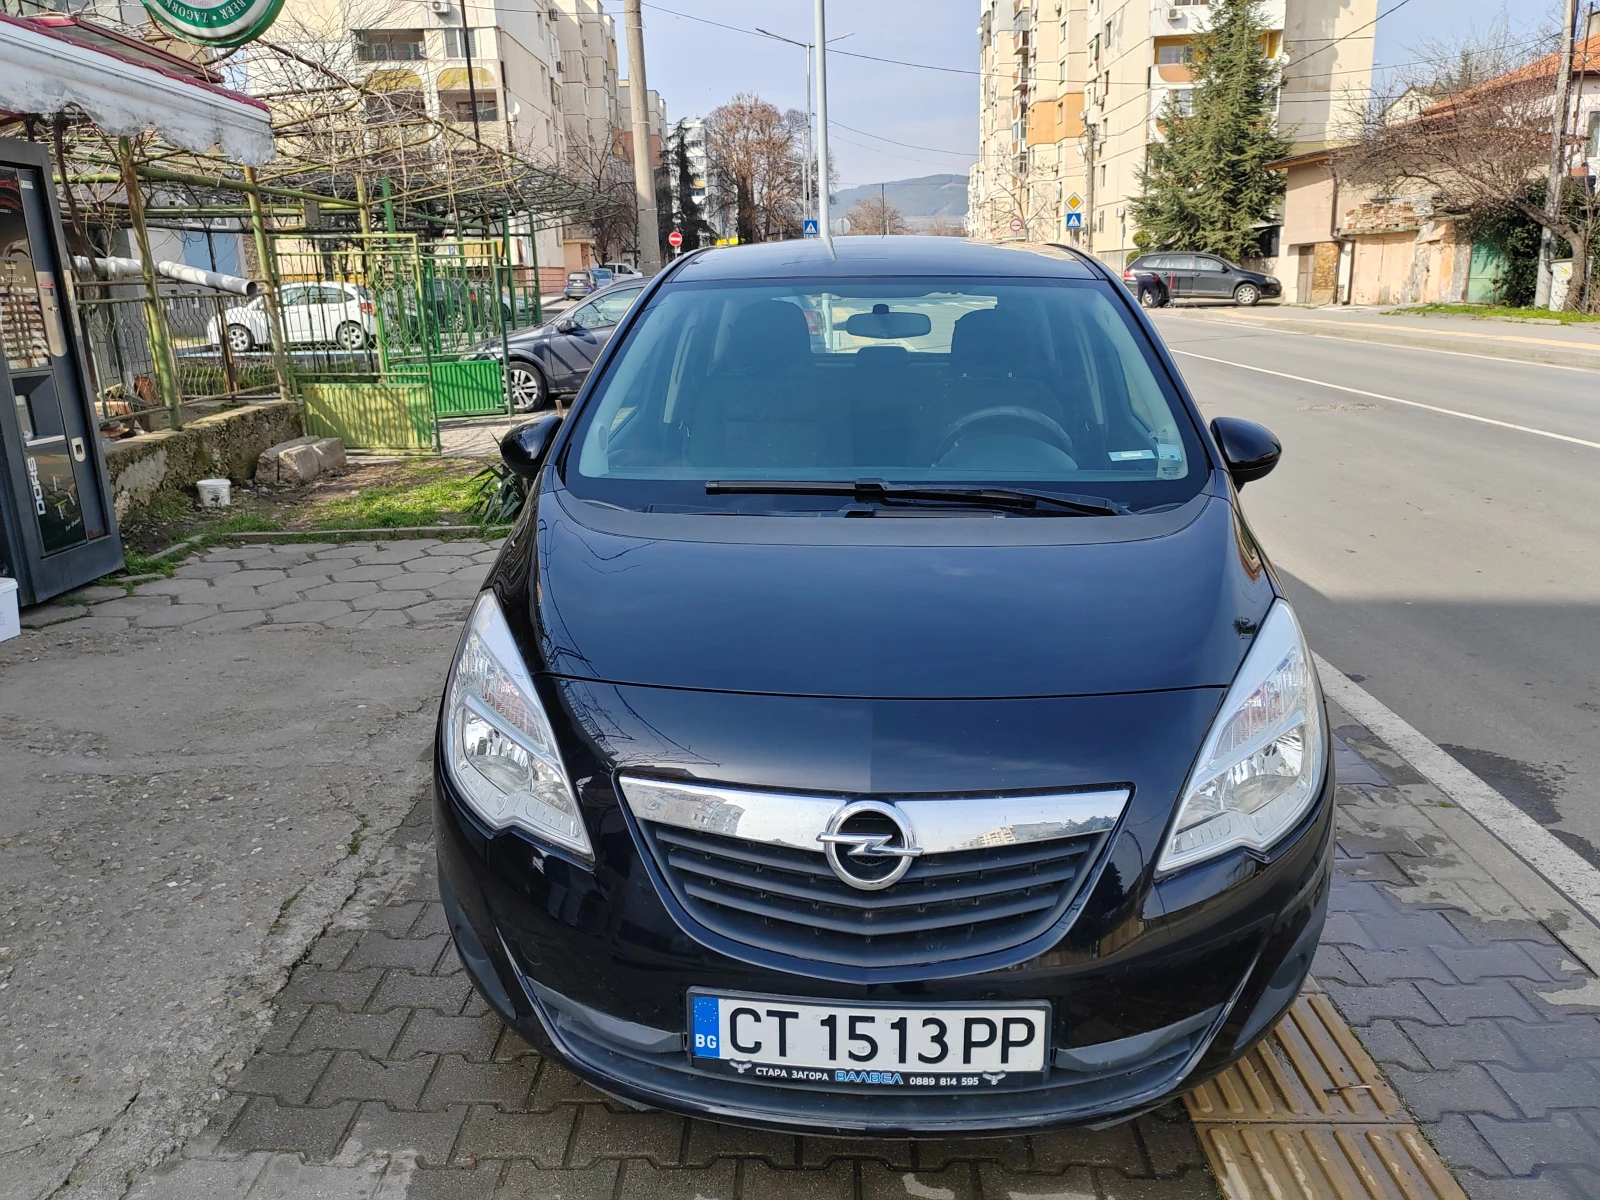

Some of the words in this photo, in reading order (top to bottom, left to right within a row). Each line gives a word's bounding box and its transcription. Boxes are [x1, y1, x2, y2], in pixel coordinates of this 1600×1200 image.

[219, 0, 247, 20] BEER
[695, 1034, 717, 1049] BG
[729, 1007, 799, 1057] CT
[820, 1013, 949, 1064] 1513
[963, 1017, 1036, 1064] PP
[755, 1067, 788, 1078] СТАРА
[791, 1070, 829, 1081] ЗАГОРА
[909, 1076, 935, 1086] 0889
[939, 1077, 957, 1086] 814
[961, 1077, 979, 1086] 595
